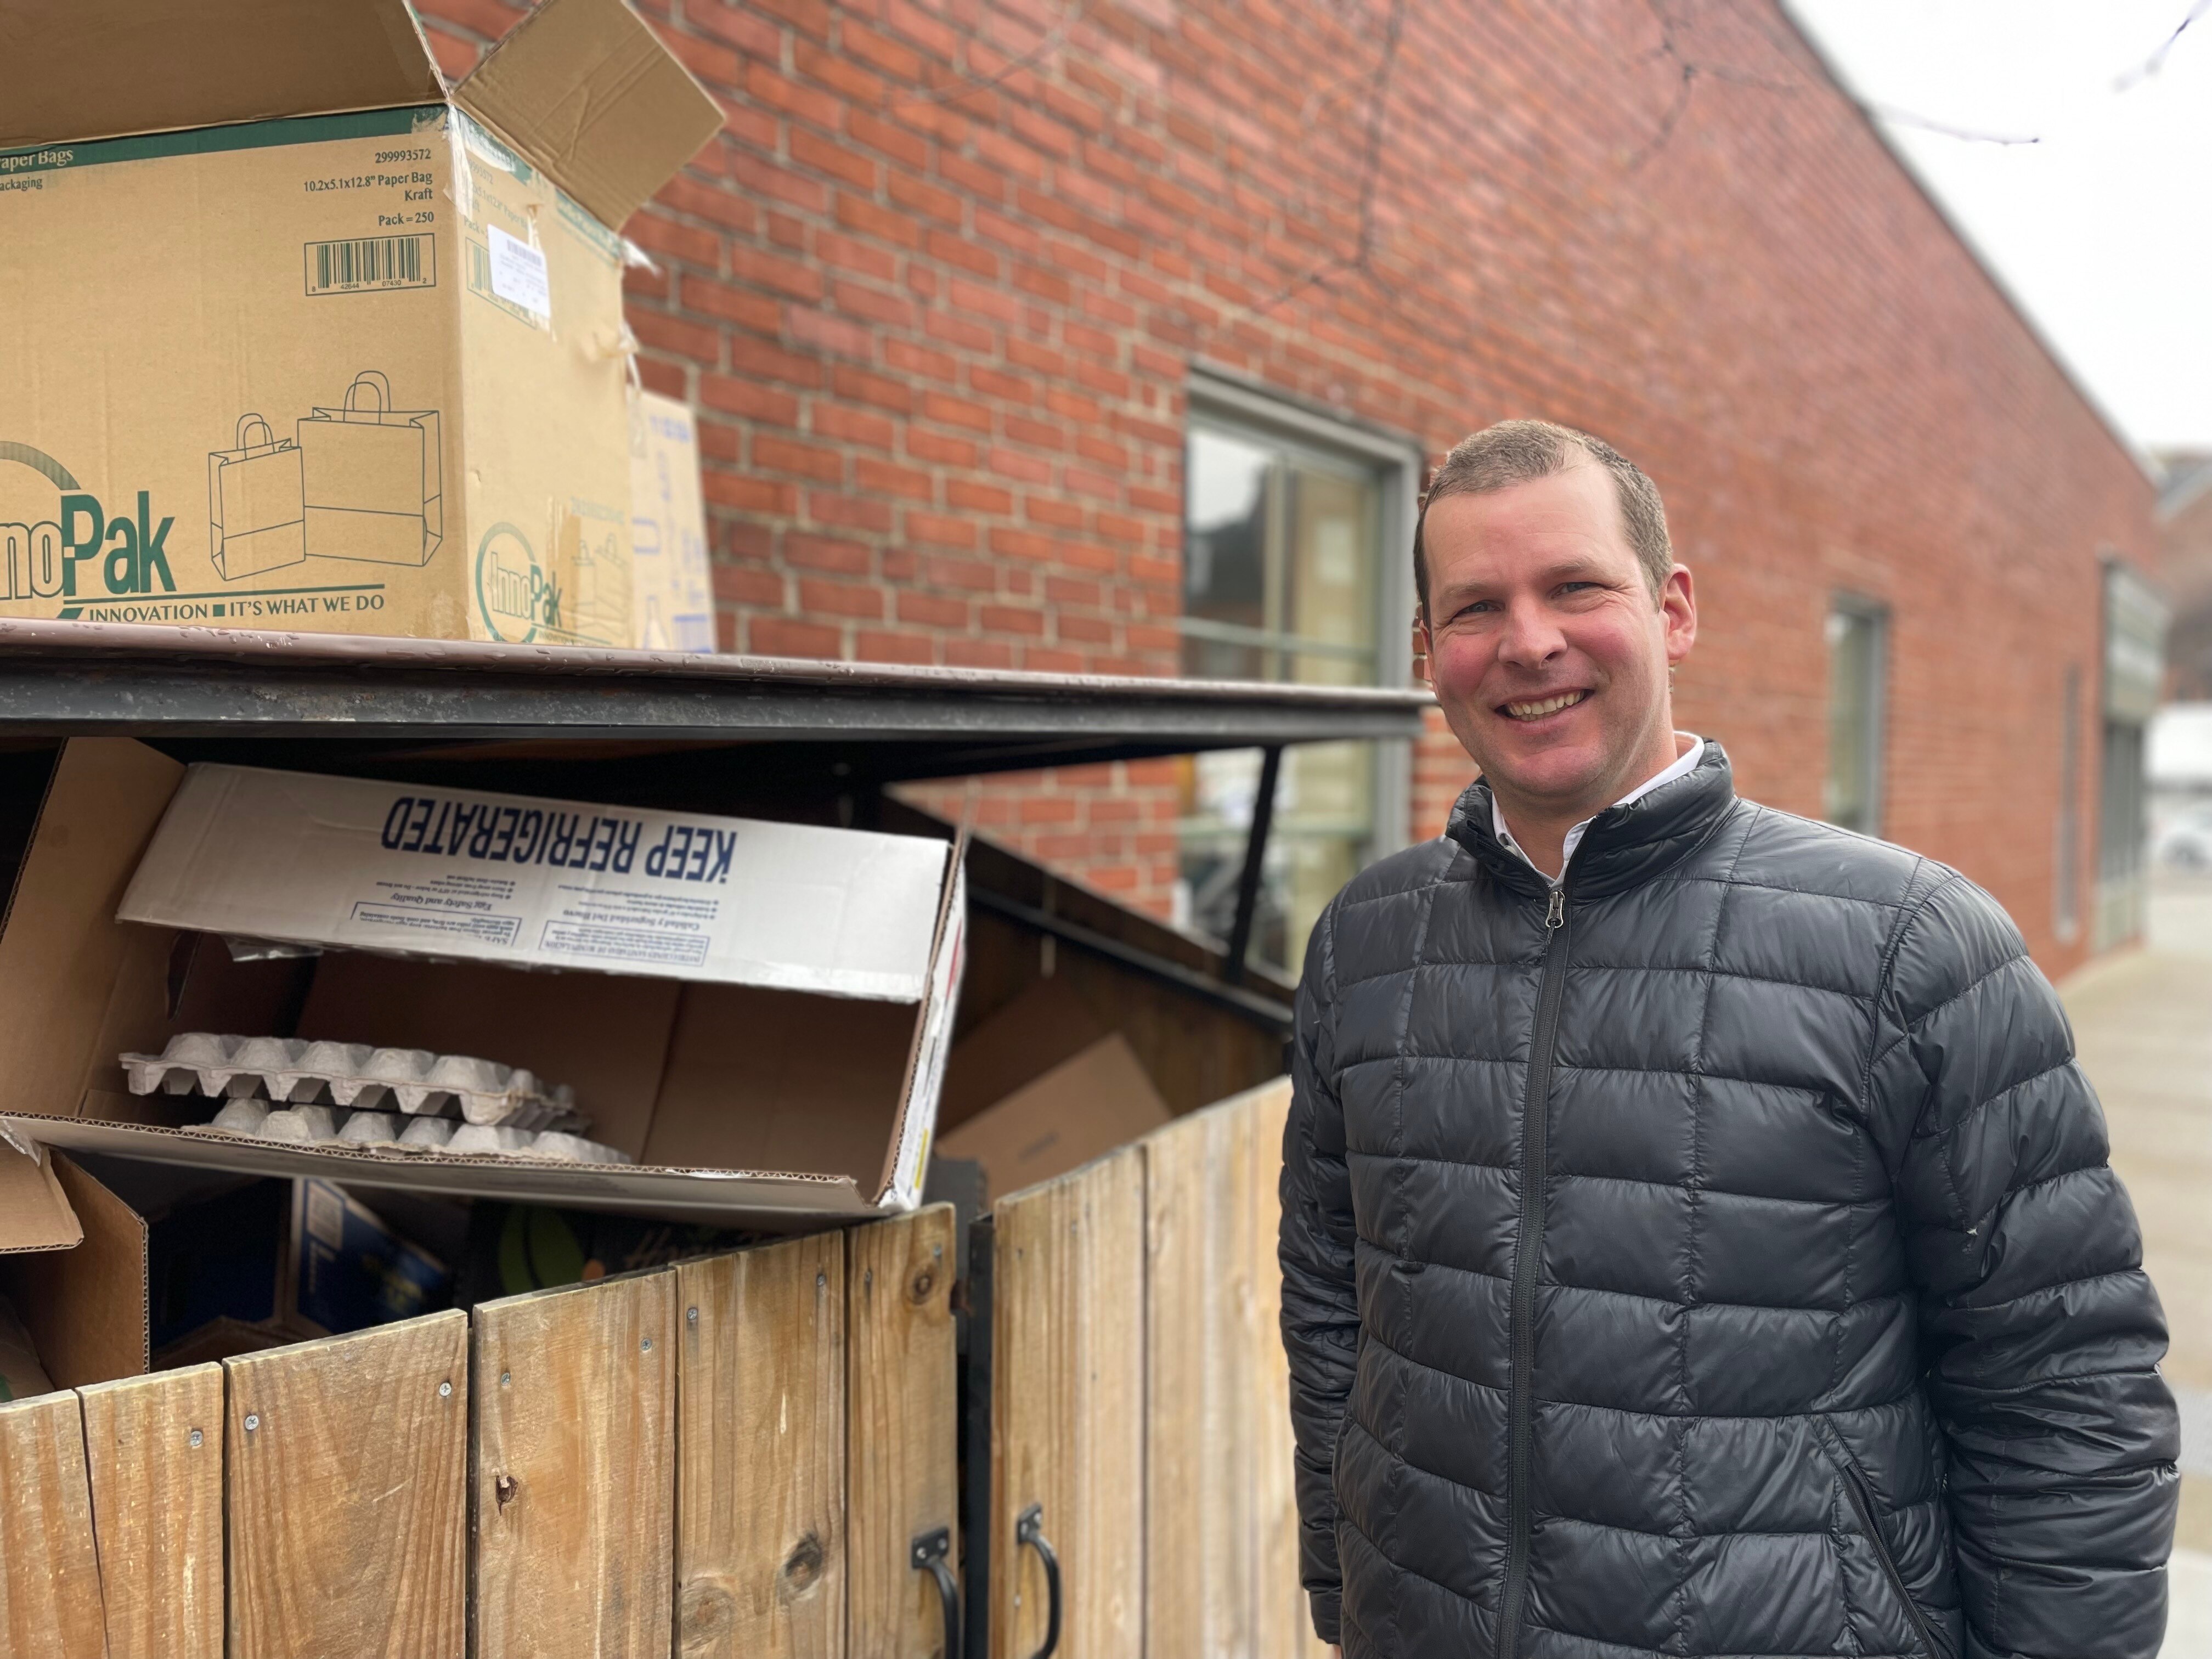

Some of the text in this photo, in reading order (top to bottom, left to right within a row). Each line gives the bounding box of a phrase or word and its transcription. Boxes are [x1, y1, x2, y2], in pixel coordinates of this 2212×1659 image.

[0, 150, 73, 172] aper Bags
[375, 149, 431, 163] 299993572
[0, 177, 42, 191] ackaging
[378, 174, 409, 188] Paper
[411, 172, 433, 184] Bag
[405, 188, 433, 201] Kraft
[379, 213, 404, 226] Pack
[415, 211, 435, 223] 250
[491, 551, 562, 628] InnoPak
[89, 604, 207, 622] INNOVATION
[266, 597, 319, 614] WHAT
[322, 596, 350, 612] WE
[356, 594, 385, 610] DO
[381, 797, 737, 884] KEEP REFRIGERATED
[390, 891, 492, 911] Egg Safety and Quality
